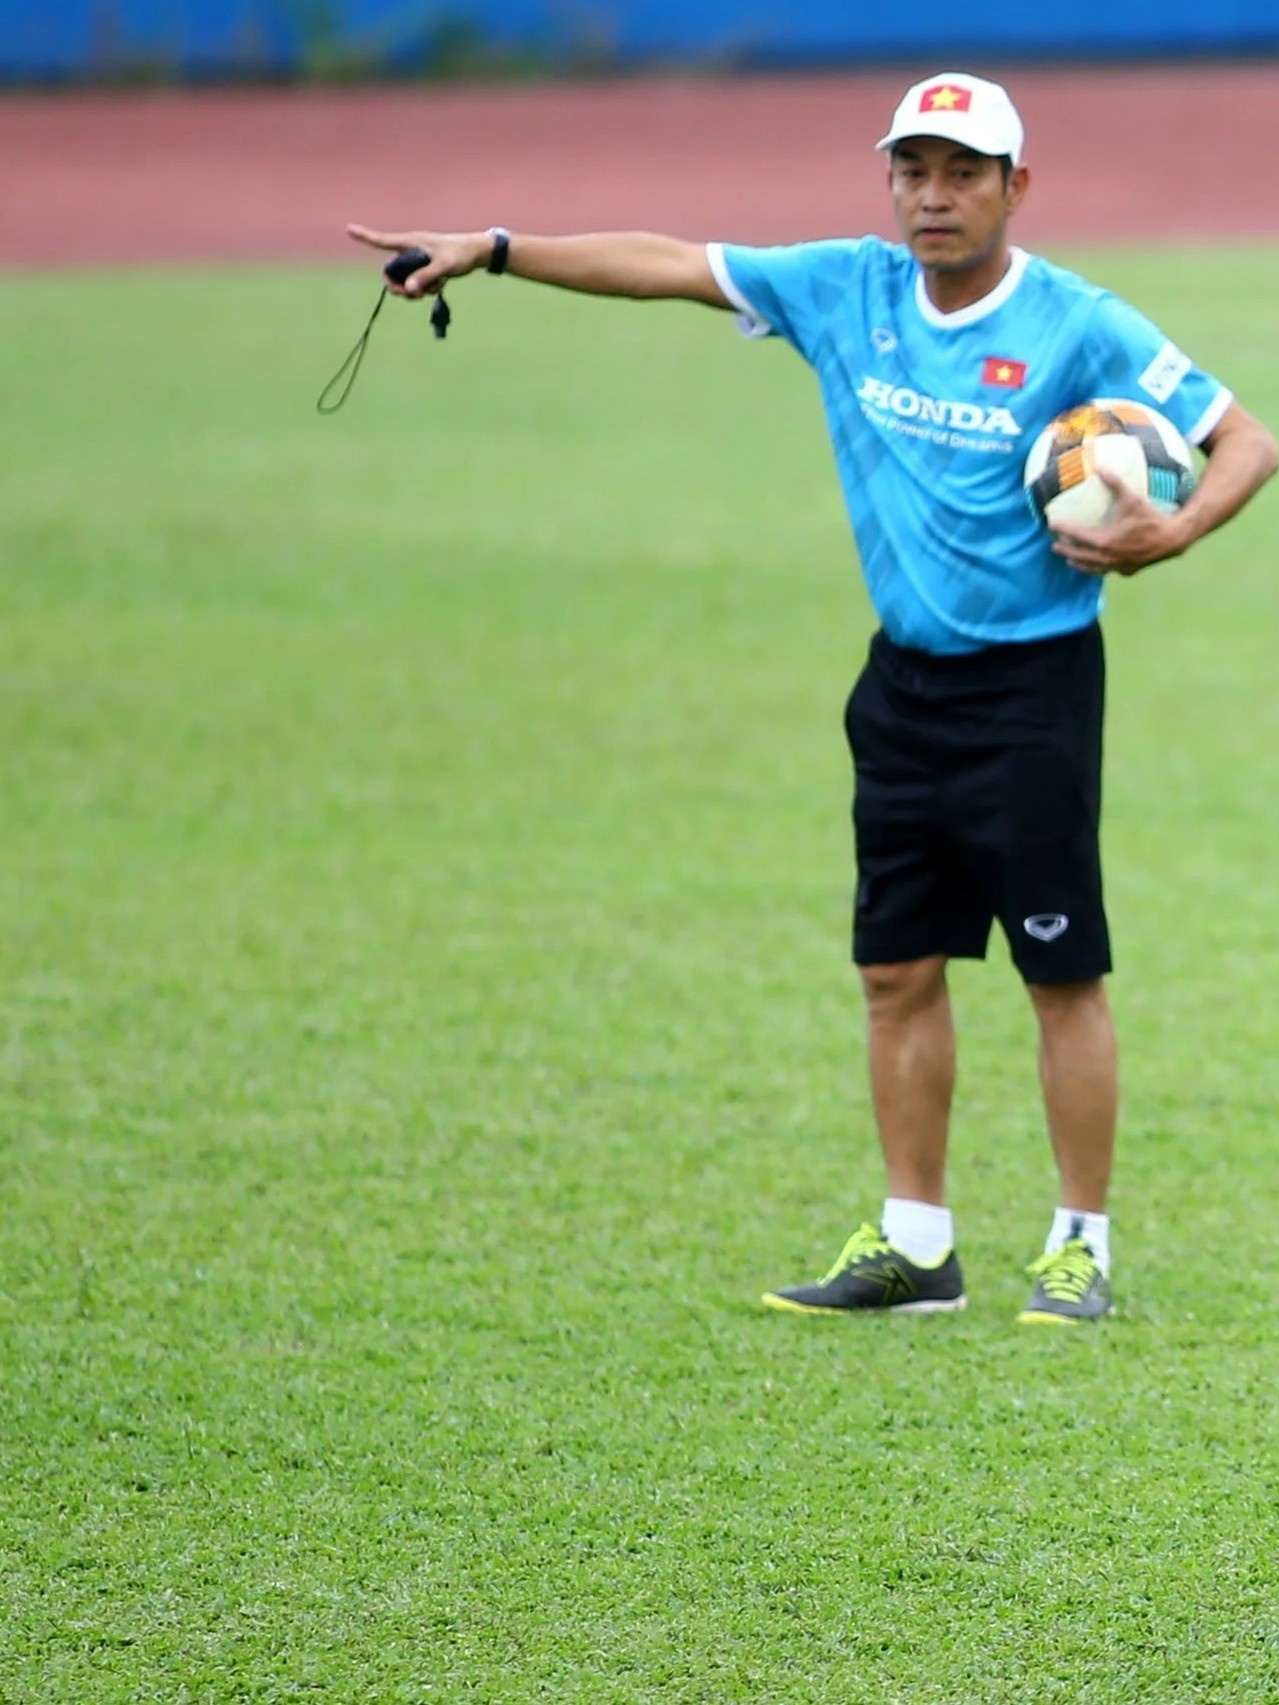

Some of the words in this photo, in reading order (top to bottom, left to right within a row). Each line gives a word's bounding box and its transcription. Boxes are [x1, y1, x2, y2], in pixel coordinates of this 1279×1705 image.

[856, 376, 1022, 436] HONDA
[931, 429, 949, 445] of
[949, 432, 1013, 453] Dreams
